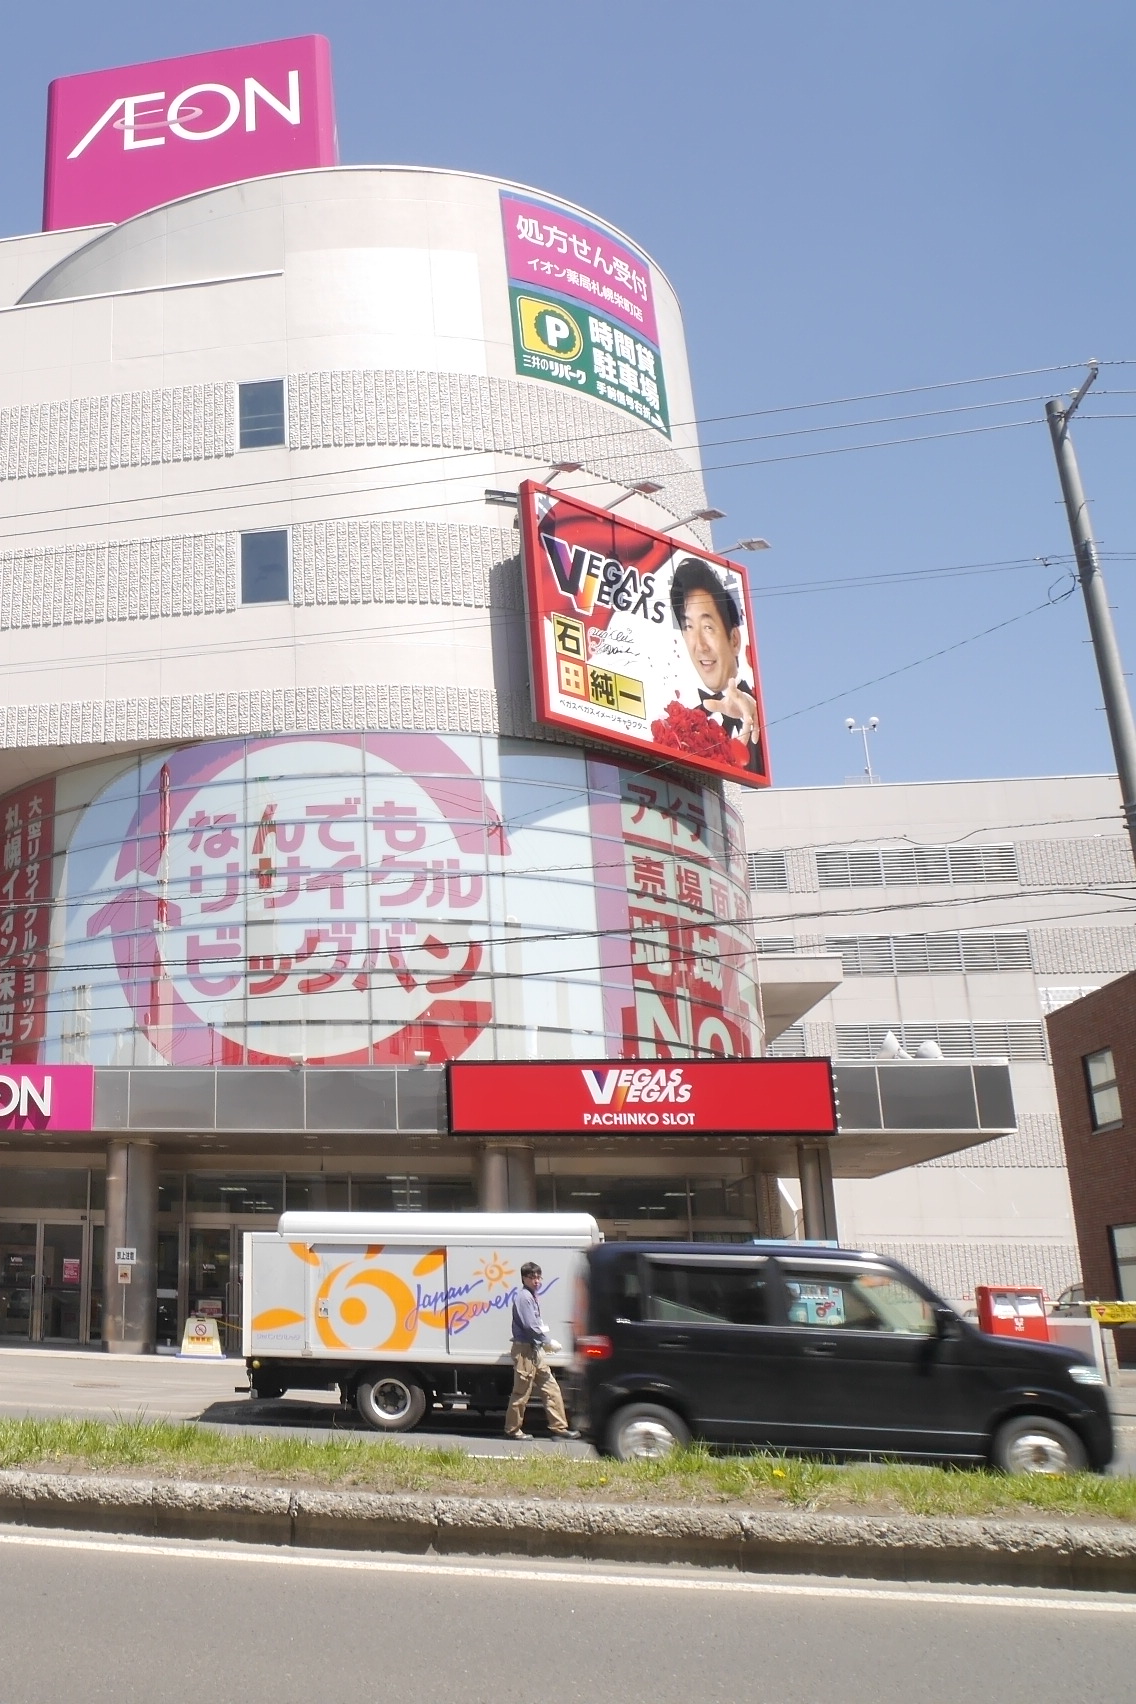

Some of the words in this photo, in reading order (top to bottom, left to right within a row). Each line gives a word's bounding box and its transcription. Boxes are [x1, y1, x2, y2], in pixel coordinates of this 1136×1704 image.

[516, 214, 648, 302] 処方せん受付
[527, 258, 644, 322] イオン薬局札幌栄町店
[545, 315, 570, 348] P
[588, 315, 657, 380] 時間貸
[522, 354, 587, 385] 三井のリパーク
[592, 347, 660, 411] 駐車場
[540, 533, 656, 598] VEGAS
[188, 797, 427, 858] なんでも
[189, 854, 483, 913] リサイクル
[185, 921, 483, 997] ビッグバン
[581, 1068, 684, 1104] VEGAS
[583, 1112, 660, 1126] PACHINKO
[661, 1112, 696, 1126] SLOT
[405, 1280, 484, 1331] Japan
